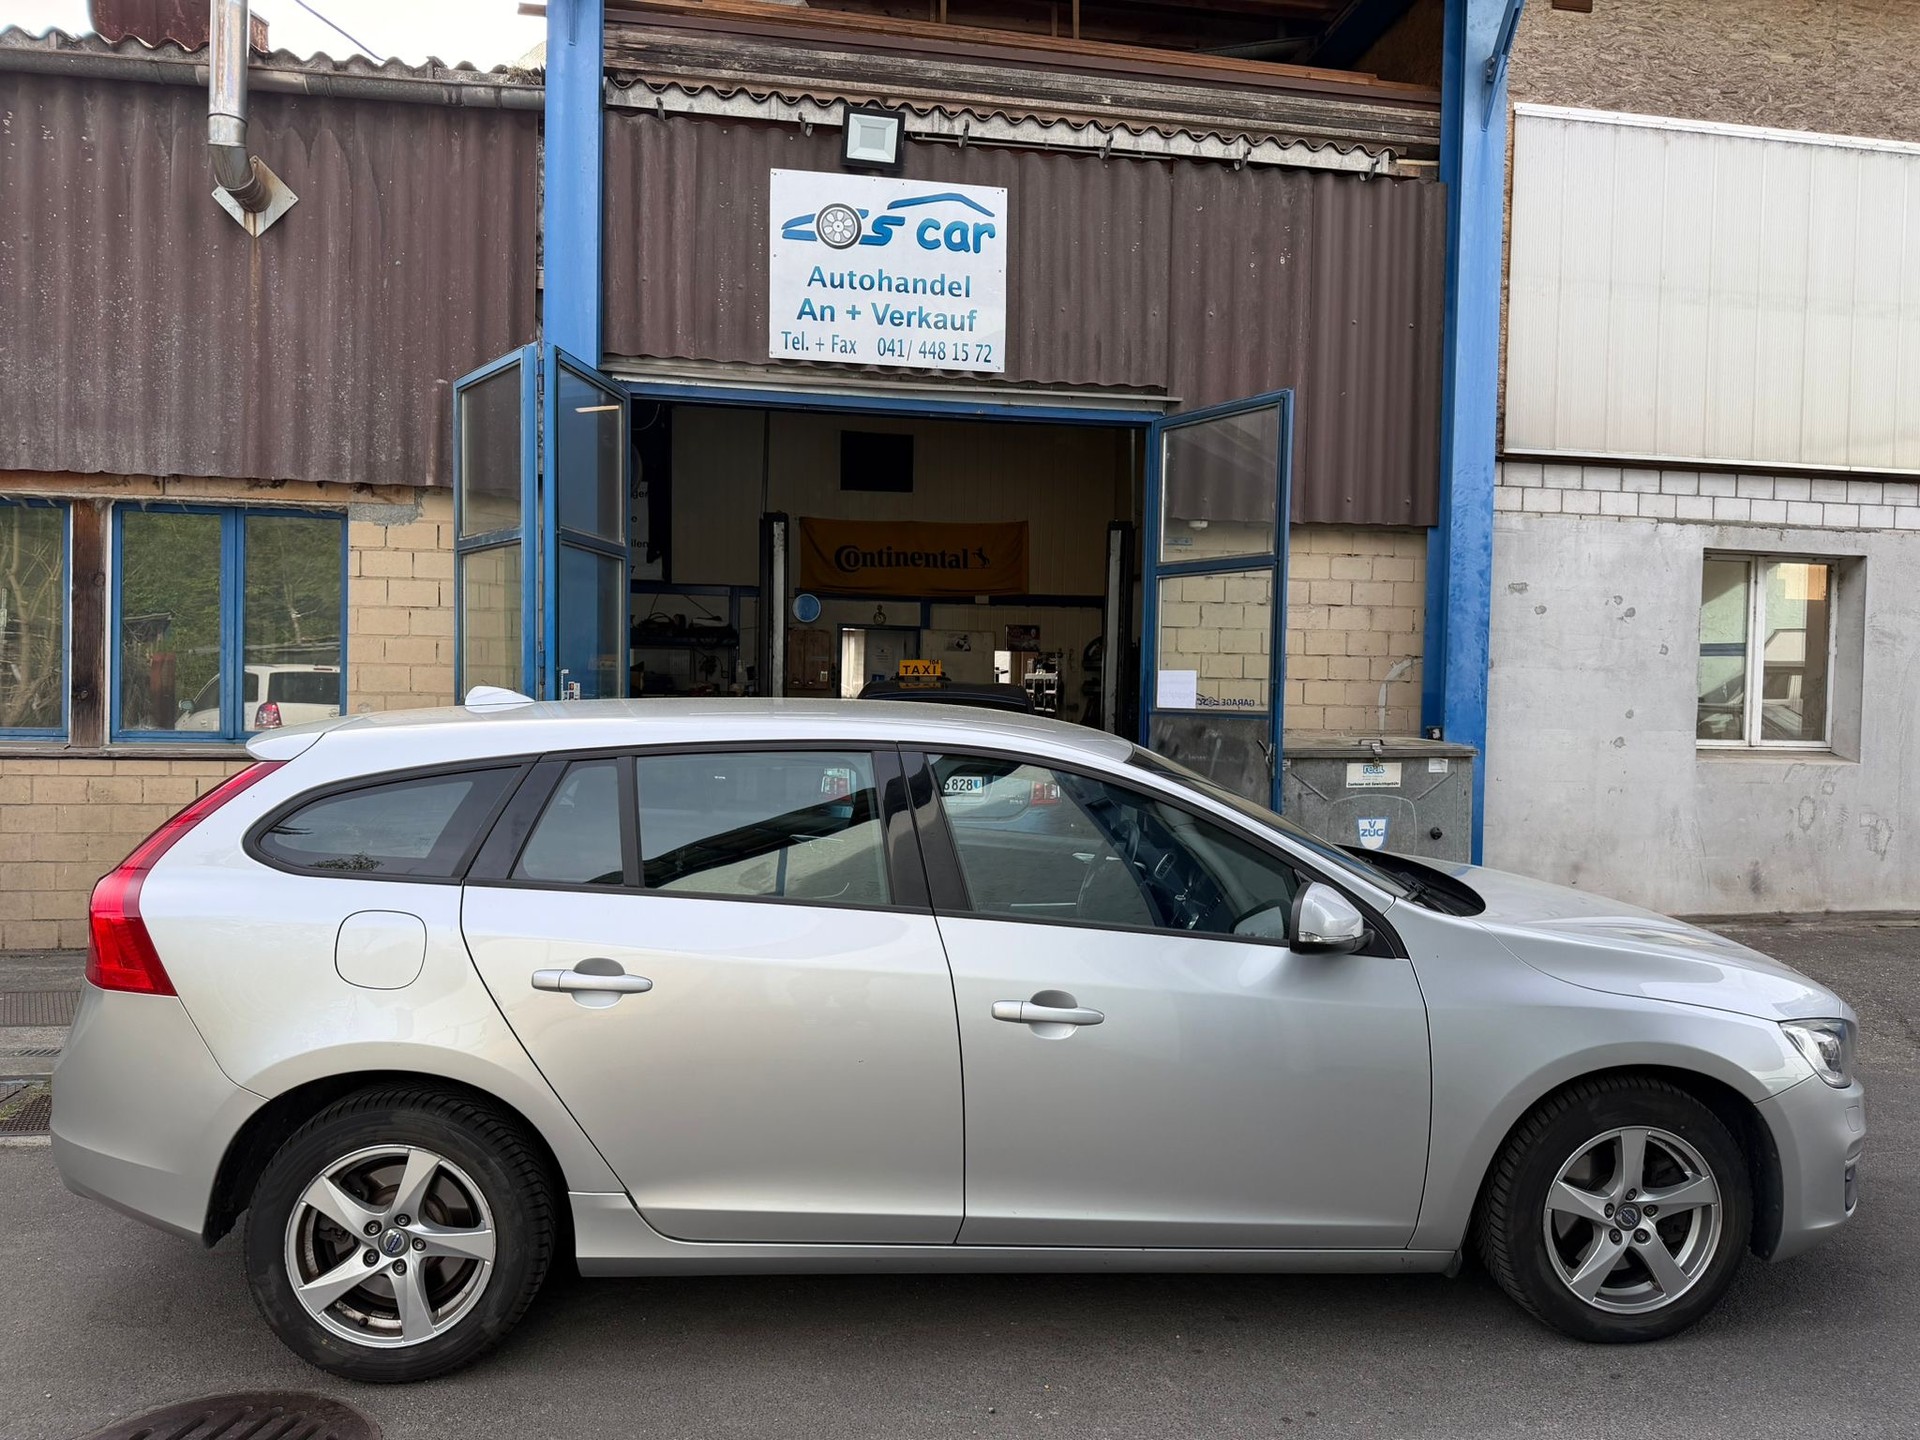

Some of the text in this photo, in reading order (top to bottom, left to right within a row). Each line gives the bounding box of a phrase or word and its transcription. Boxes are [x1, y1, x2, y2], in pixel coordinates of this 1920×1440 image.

[916, 217, 996, 253] car
[807, 265, 971, 298] Autohandel
[796, 297, 978, 332] An + Verkauf
[781, 330, 809, 352] Tel.
[815, 336, 825, 352] +
[831, 334, 857, 355] Fax
[918, 340, 946, 361] 448
[952, 342, 969, 362] 15
[975, 343, 992, 364] 72
[835, 545, 969, 573] Continental
[903, 665, 937, 675] TAXI
[1368, 820, 1377, 829] V
